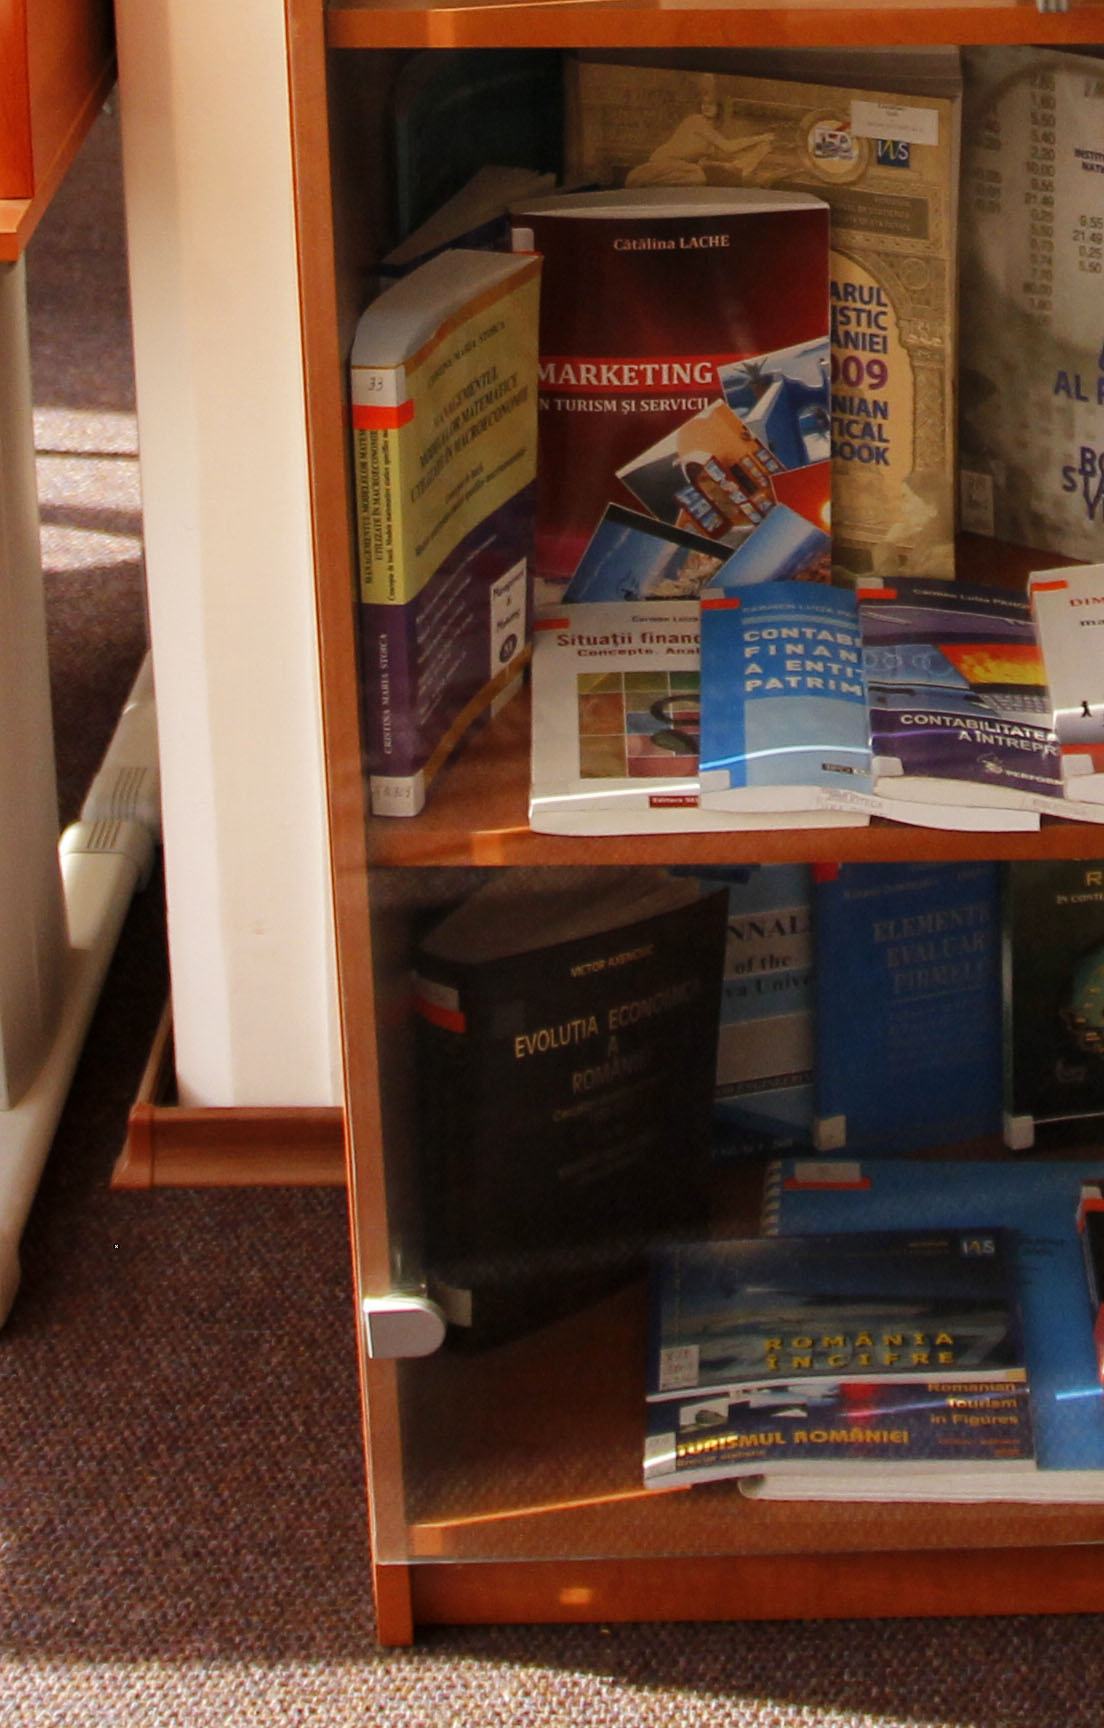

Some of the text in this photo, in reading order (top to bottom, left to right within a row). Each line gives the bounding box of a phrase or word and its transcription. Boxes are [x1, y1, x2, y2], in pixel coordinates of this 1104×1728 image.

[613, 234, 730, 251] Cătălina LACHE
[539, 361, 713, 388] MARKETING
[1054, 370, 1088, 402] AL
[555, 396, 615, 413] TURISM
[642, 396, 710, 412] SERVICII
[558, 632, 636, 648] Situații
[746, 662, 763, 675] A
[381, 672, 391, 707] MARIA
[382, 709, 393, 754] CRISTINA
[957, 730, 972, 742] A
[608, 1036, 619, 1057] A
[764, 1331, 953, 1351] ROMÂNIA
[825, 1351, 953, 1368] CIFRE
[928, 1382, 1016, 1393] Romanian
[930, 1414, 1019, 1427] in Figures
[793, 1429, 908, 1445] ROMÂNIEI
